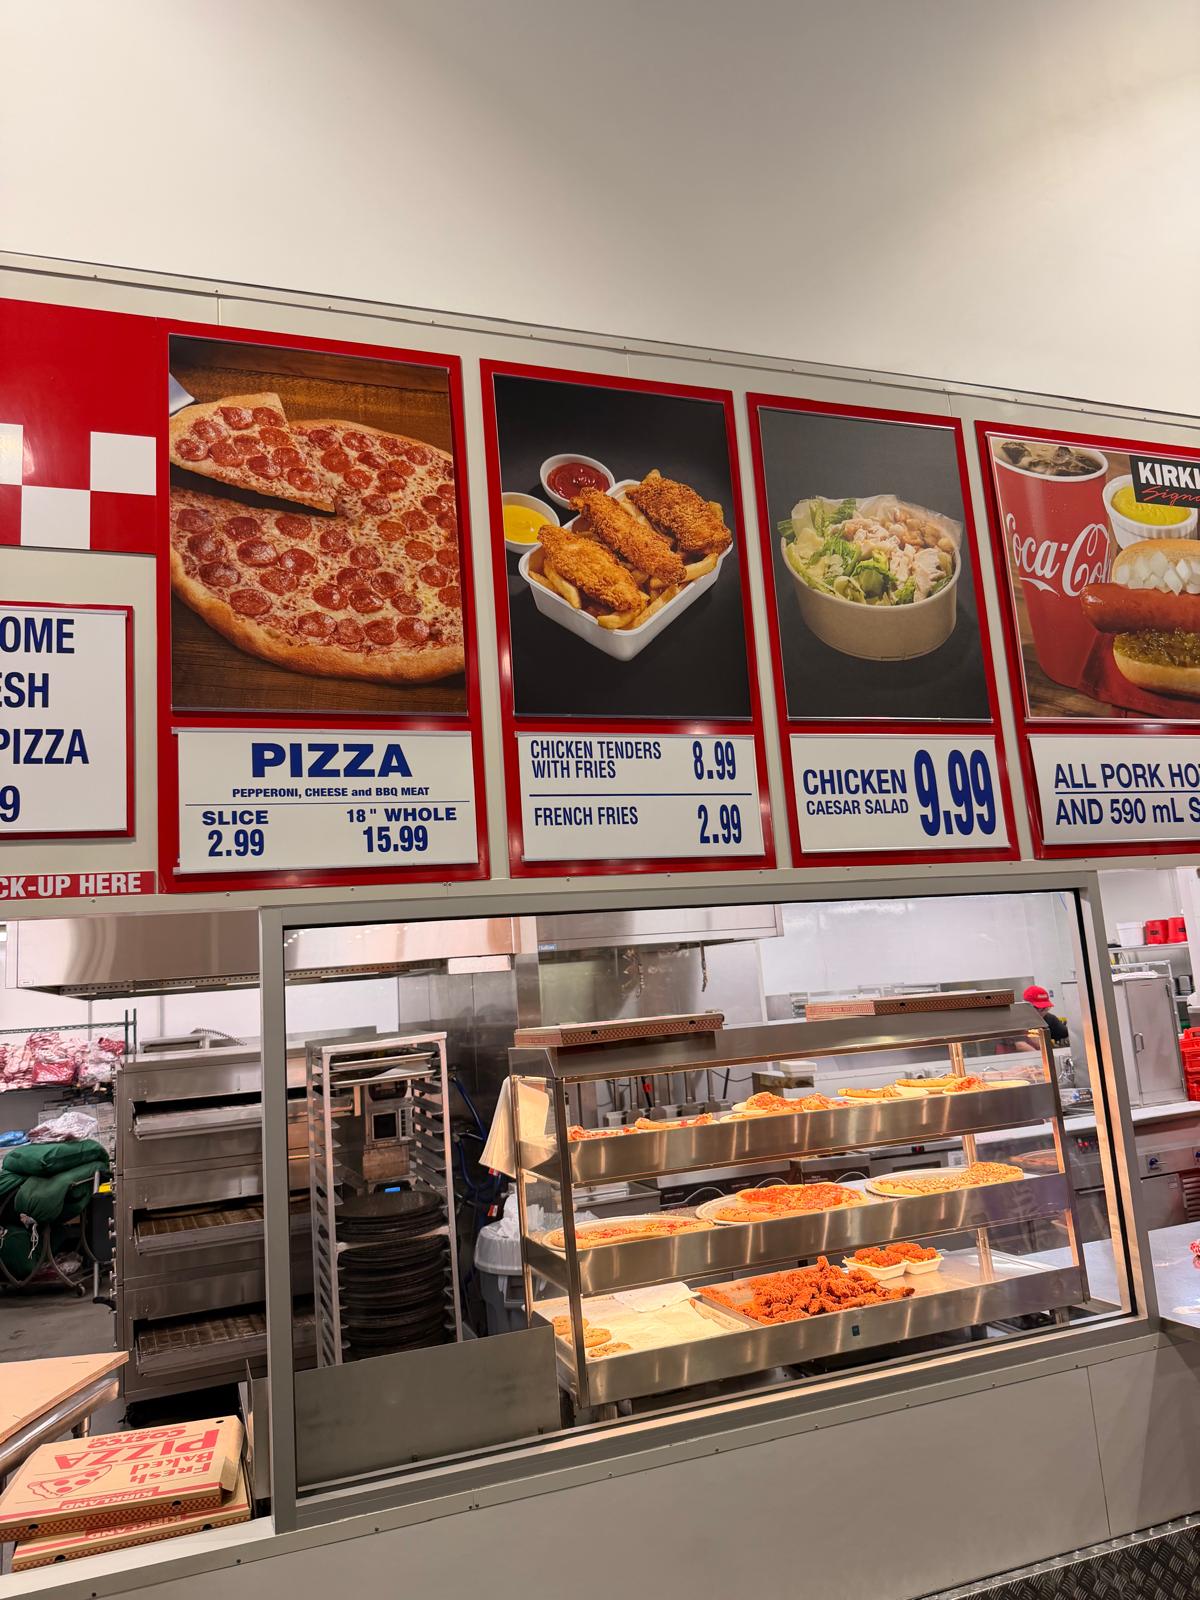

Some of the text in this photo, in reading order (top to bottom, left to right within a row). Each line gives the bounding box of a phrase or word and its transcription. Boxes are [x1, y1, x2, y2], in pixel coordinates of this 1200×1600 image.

[0, 616, 74, 653] OME
[0, 672, 49, 708] SH
[252, 743, 412, 777] PIZZA
[531, 740, 661, 759] CHICKEN TENDERS
[693, 741, 736, 780] 8.99
[532, 760, 616, 778] WITH FRIES
[1055, 763, 1200, 788] ALL PORK HO
[233, 787, 429, 798] PEPPERONI, CHEESE and BBQ MEAT
[803, 769, 907, 795] CHICKEN
[914, 750, 997, 836] 9.99
[202, 810, 268, 825] SLICE
[384, 808, 456, 821] WHOLE
[535, 807, 638, 826] FRENCH FRIES
[807, 799, 908, 815] CAESAR SALAD
[1056, 799, 1103, 825] AND
[1111, 798, 1146, 824] 590
[1152, 798, 1184, 823] mL
[698, 804, 741, 844] 2.99
[208, 829, 264, 857] 2.99
[363, 825, 428, 852] 15.99
[80, 873, 141, 894] HERE
[55, 1429, 220, 1469] PIZZA
[87, 1429, 186, 1449] COSTCO
[62, 1491, 153, 1510] KIRKLAND
